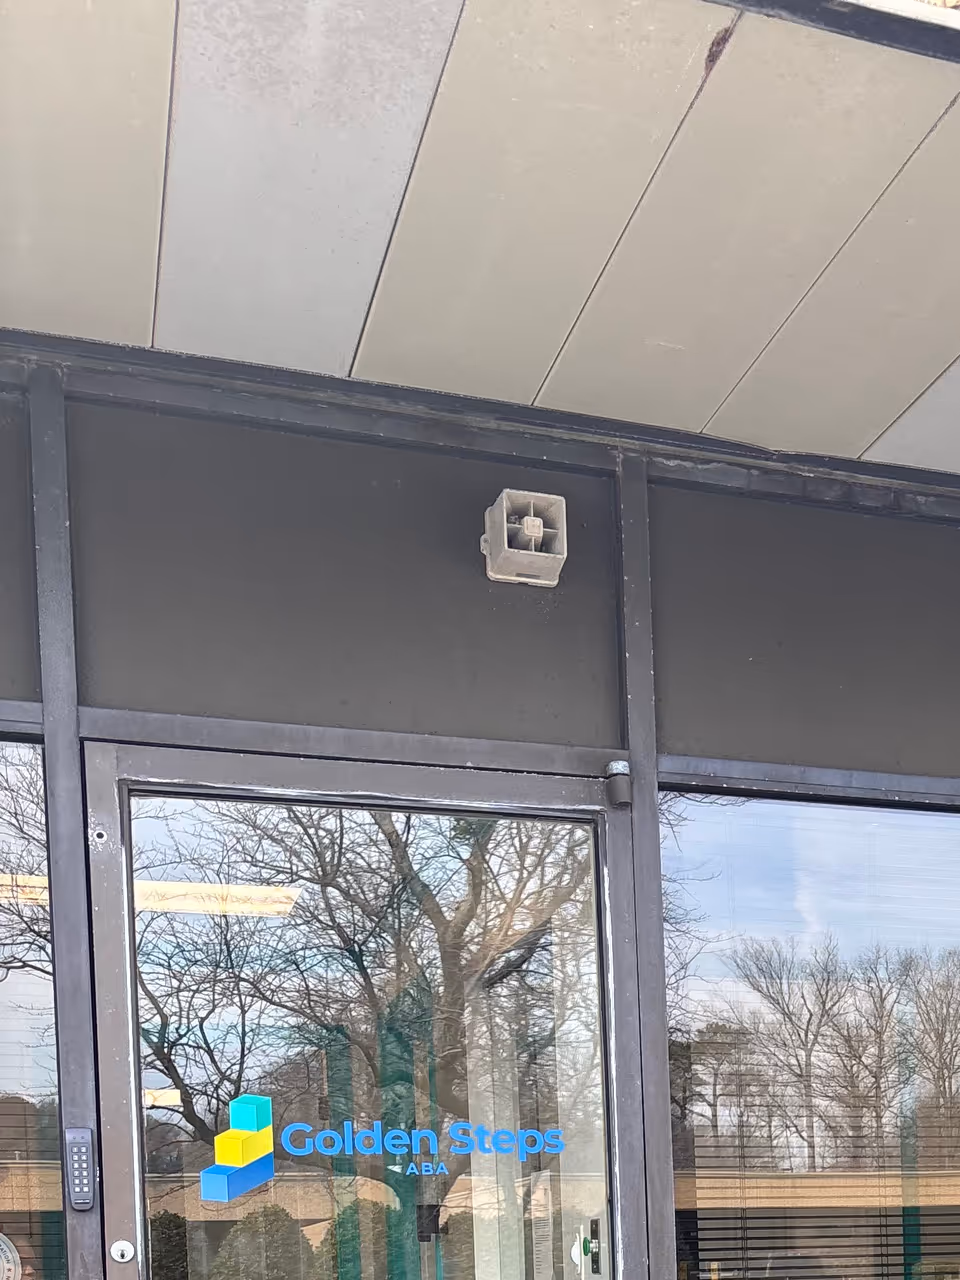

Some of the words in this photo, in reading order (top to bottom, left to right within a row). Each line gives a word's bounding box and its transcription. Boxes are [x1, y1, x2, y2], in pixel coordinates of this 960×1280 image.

[280, 1120, 438, 1156] Golden
[448, 1121, 566, 1162] Steps
[405, 1162, 449, 1176] ABA
